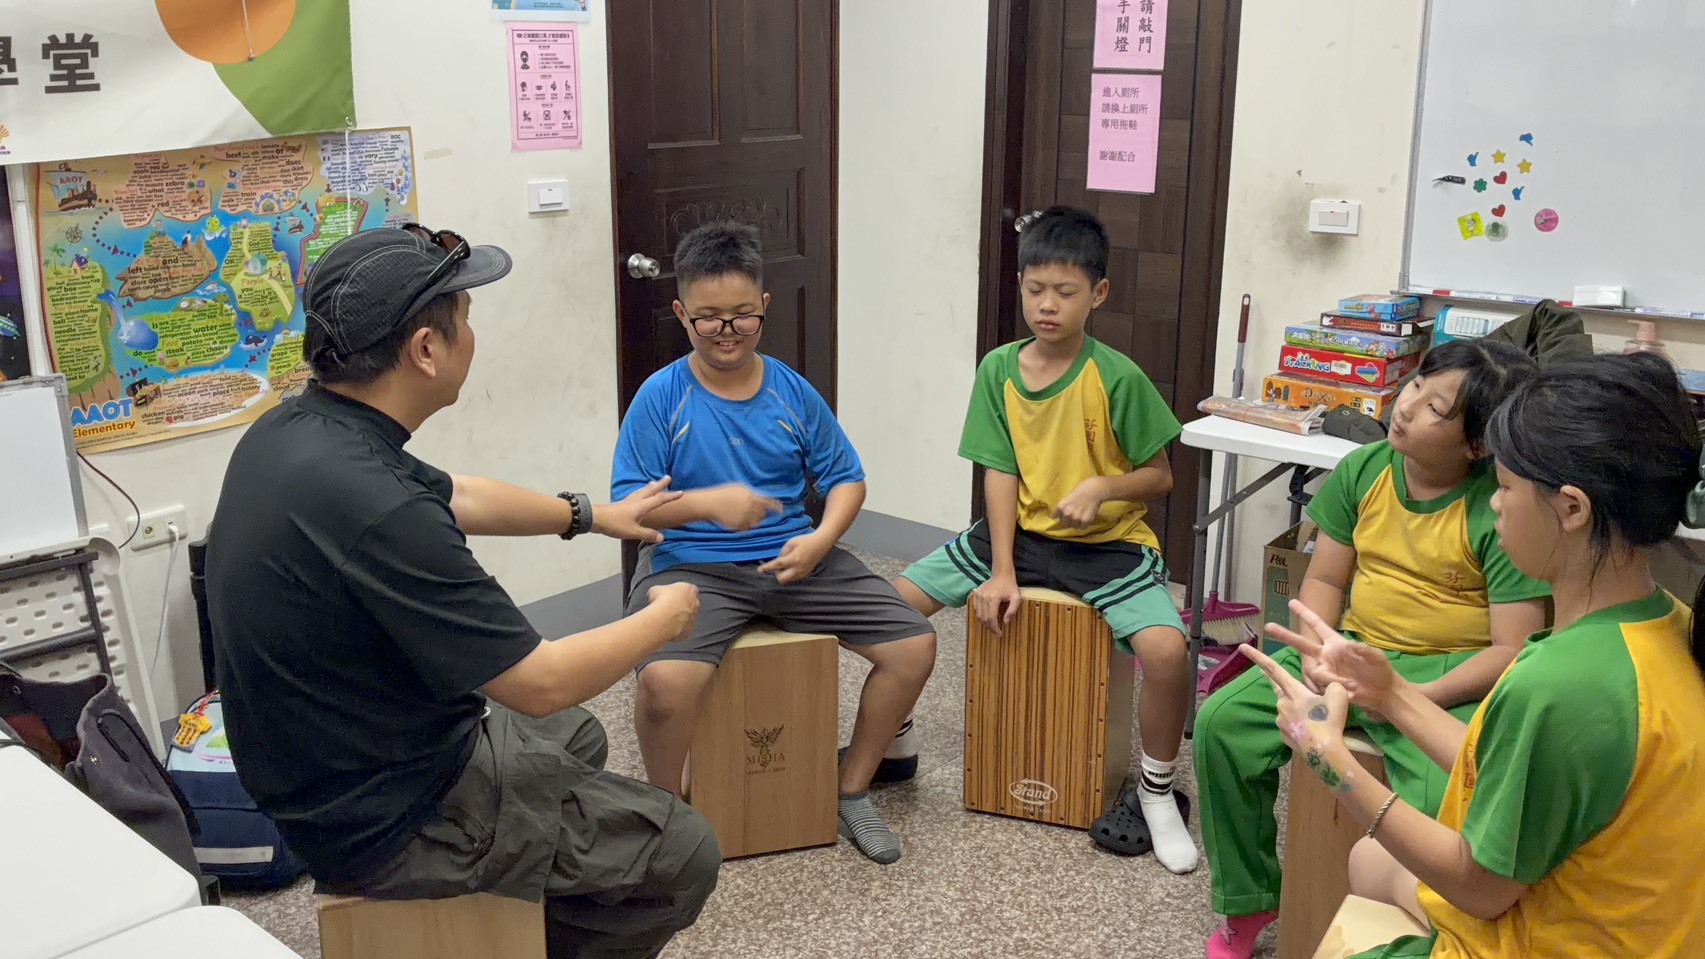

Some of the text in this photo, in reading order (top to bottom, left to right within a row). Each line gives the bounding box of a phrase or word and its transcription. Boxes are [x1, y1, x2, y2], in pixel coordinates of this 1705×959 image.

[1103, 87, 1140, 98] 進入廁所
[1101, 103, 1148, 115] 請換上廁所
[1100, 119, 1138, 131] 專用拖鞋
[1100, 151, 1136, 162] 謝謝配合
[162, 256, 179, 265] and
[193, 325, 218, 333] water
[70, 398, 133, 426] AAOT
[73, 421, 135, 438] Elementary
